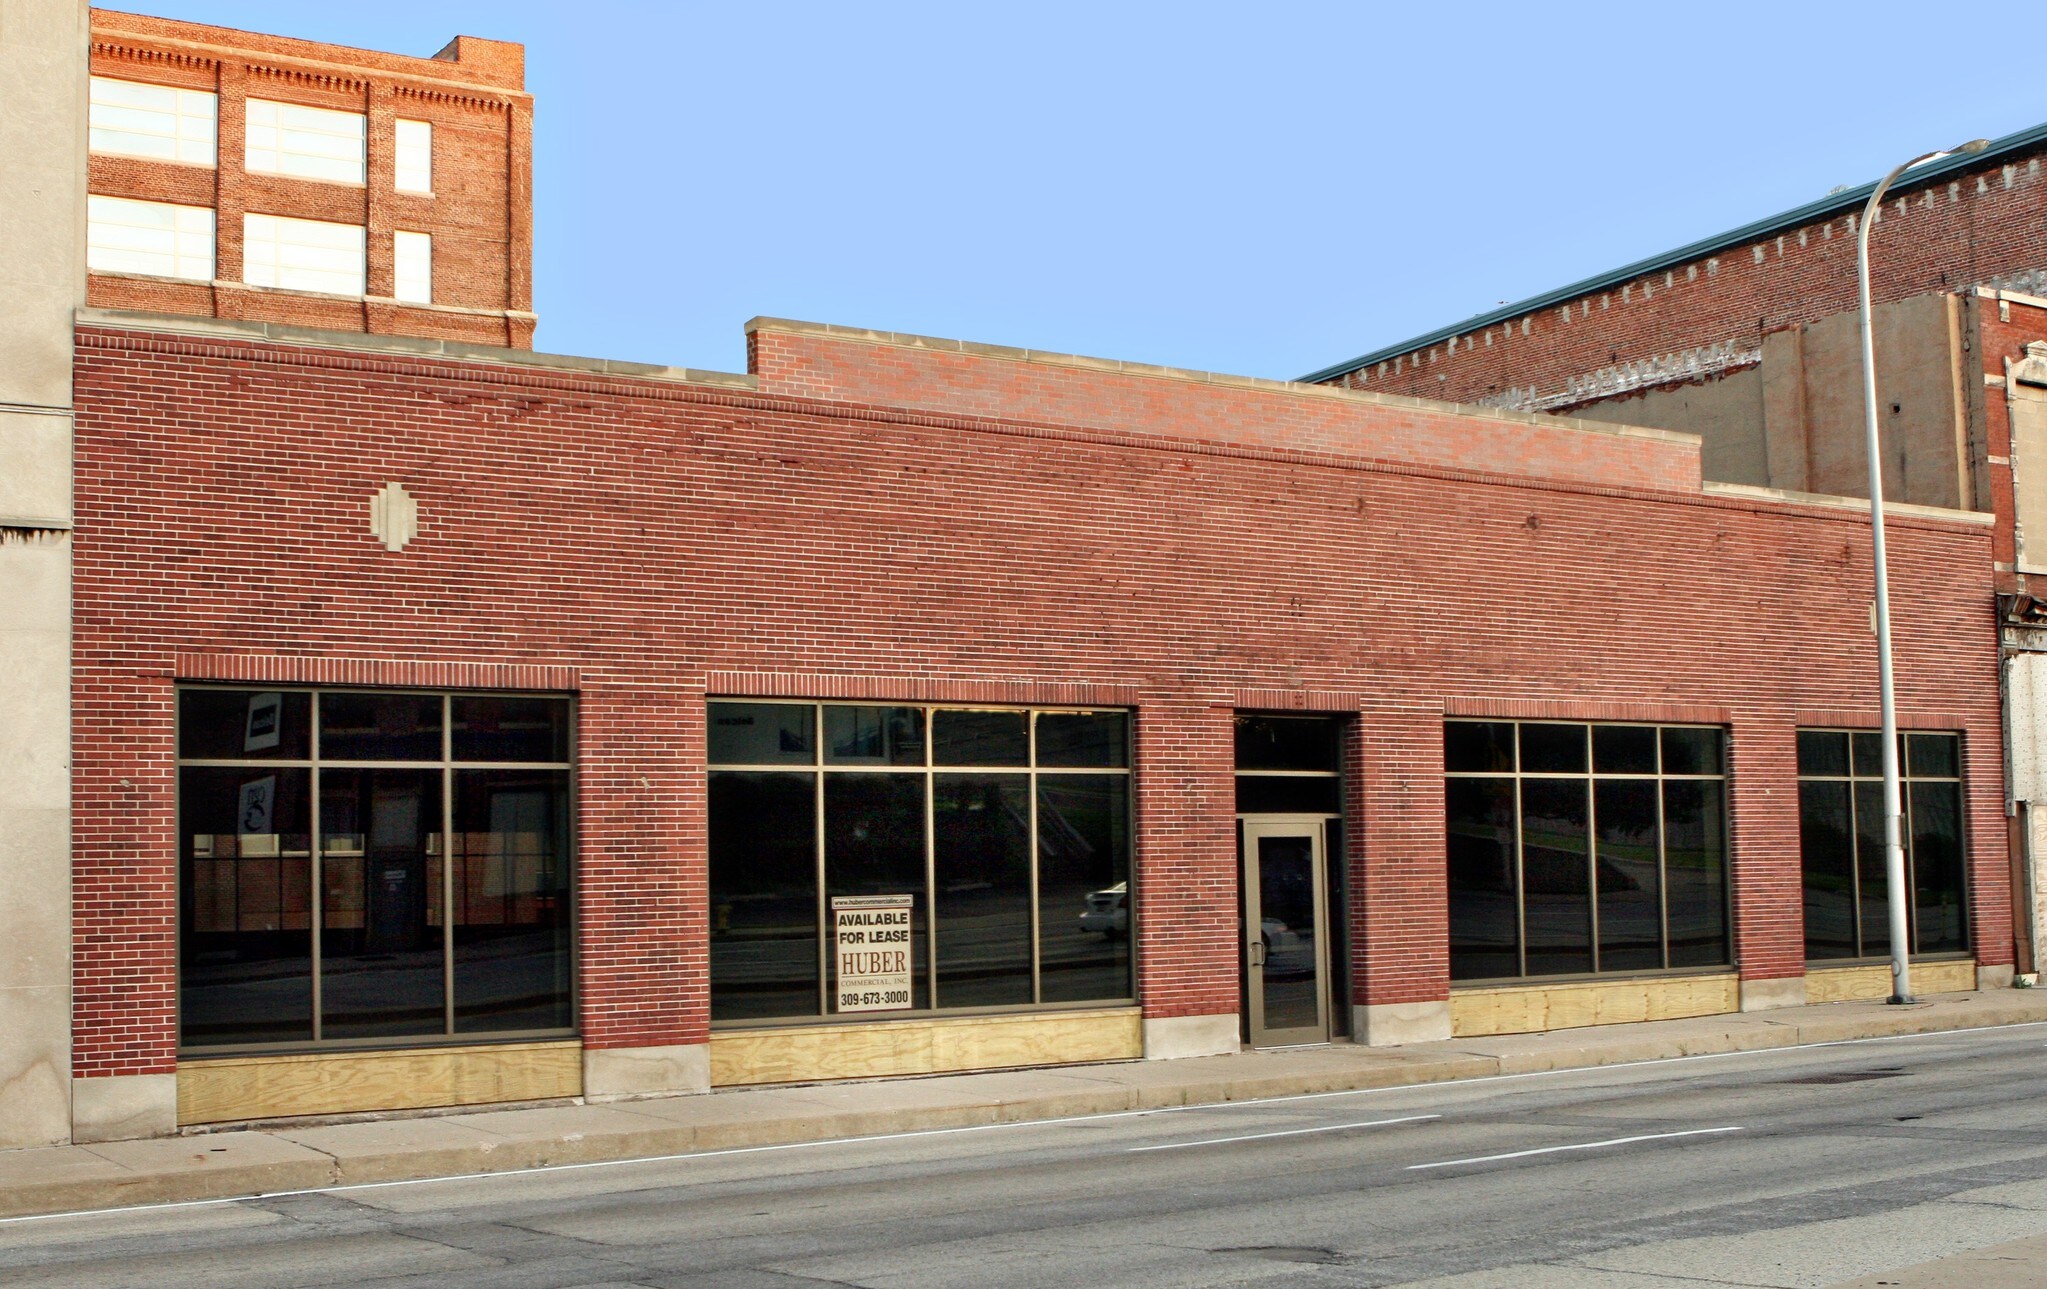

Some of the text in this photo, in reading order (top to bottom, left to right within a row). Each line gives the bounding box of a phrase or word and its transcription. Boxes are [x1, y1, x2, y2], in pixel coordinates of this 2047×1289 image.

[839, 913, 908, 926] AVAILABLE
[840, 930, 908, 944] FOR LEASE
[842, 951, 906, 974] HUBER
[841, 991, 908, 1006] 309-673-3000
